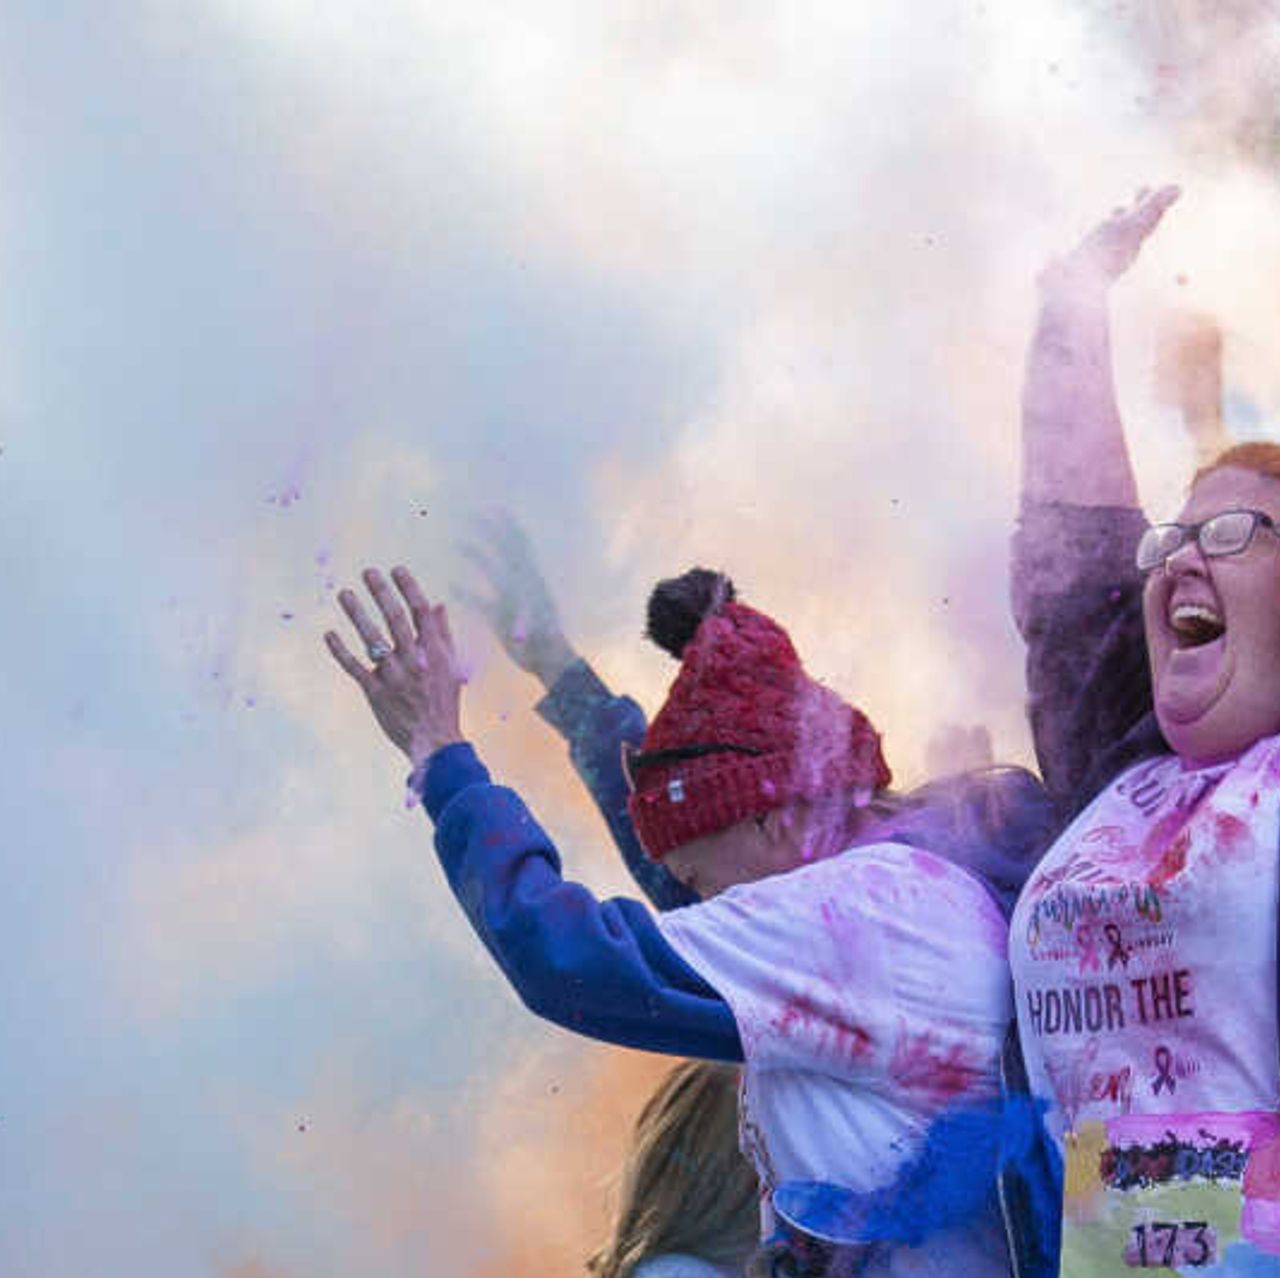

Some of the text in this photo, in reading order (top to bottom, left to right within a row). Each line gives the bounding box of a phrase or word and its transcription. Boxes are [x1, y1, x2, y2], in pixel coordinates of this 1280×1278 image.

[1026, 968, 1195, 1038] HONOR THE
[1132, 1220, 1210, 1268] 173
